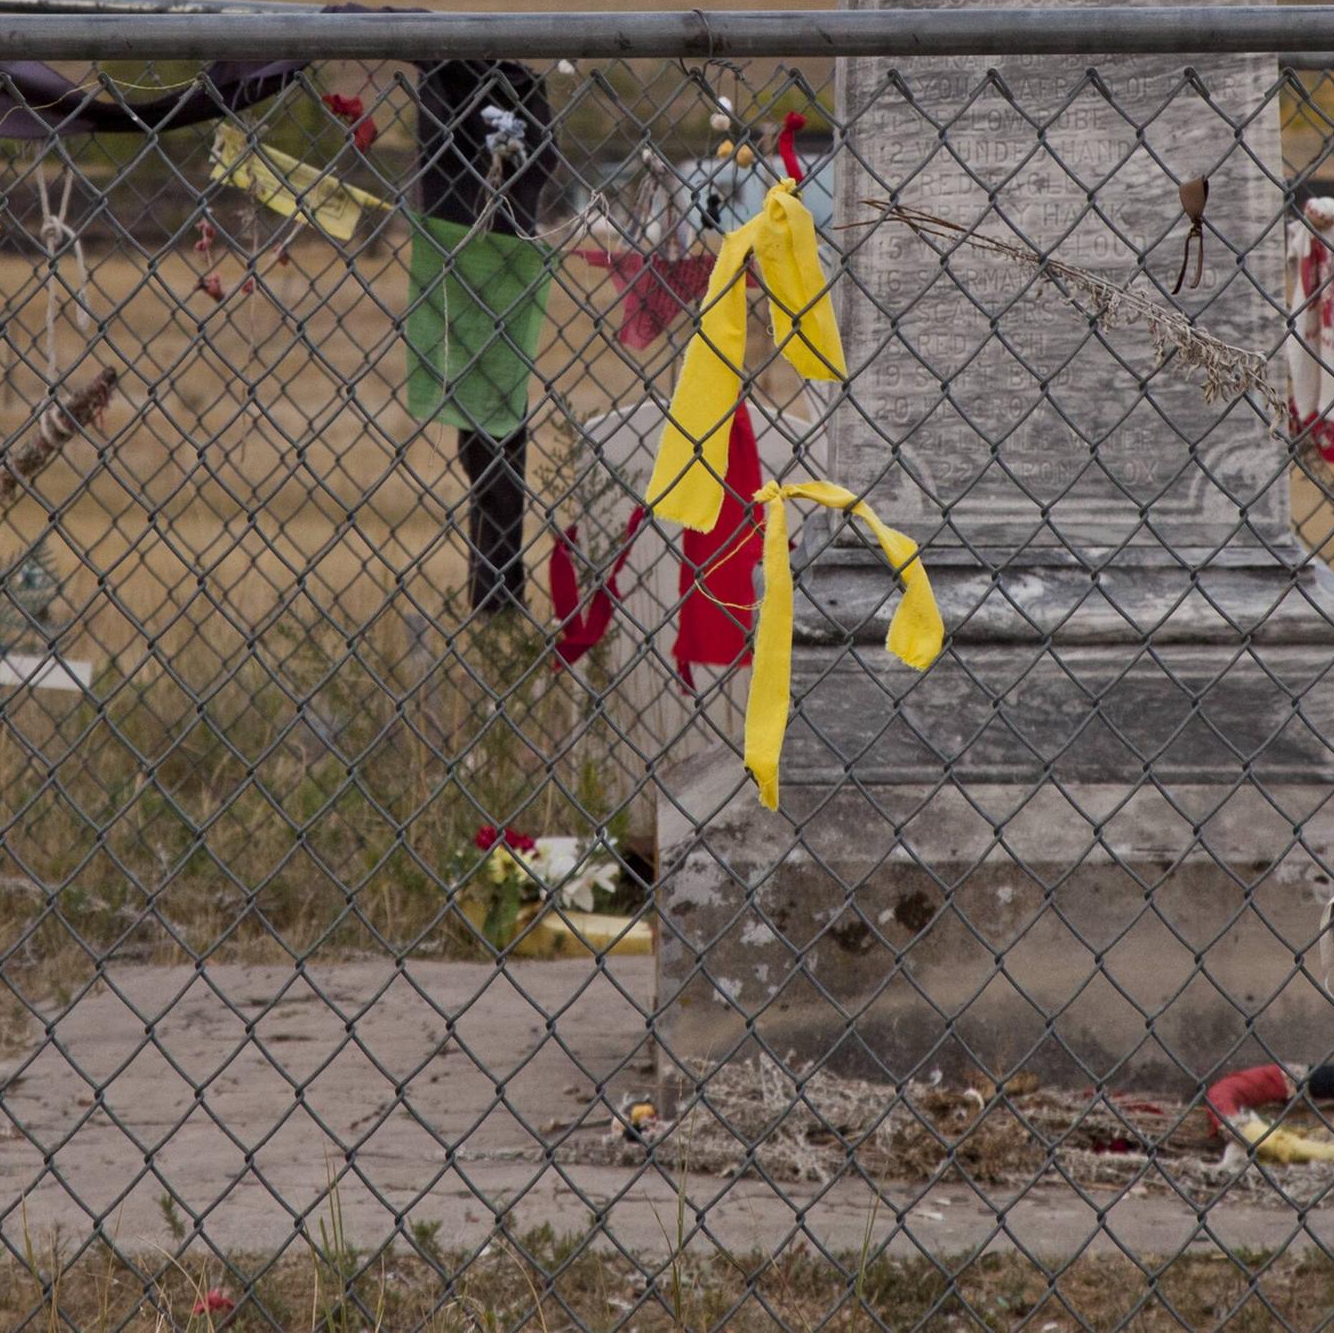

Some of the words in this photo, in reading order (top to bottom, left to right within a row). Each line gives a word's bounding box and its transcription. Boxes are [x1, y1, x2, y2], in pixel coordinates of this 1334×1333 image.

[919, 75, 1000, 99] YOU
[1019, 76, 1116, 99] AFRID
[1168, 75, 1237, 98] BR
[1061, 140, 1132, 164] HAND
[920, 172, 972, 196] RED
[919, 203, 1030, 227] PRETY
[917, 267, 1033, 292] SERMAN
[917, 333, 966, 356] RED
[875, 363, 902, 388] 19
[875, 395, 910, 422] 20
